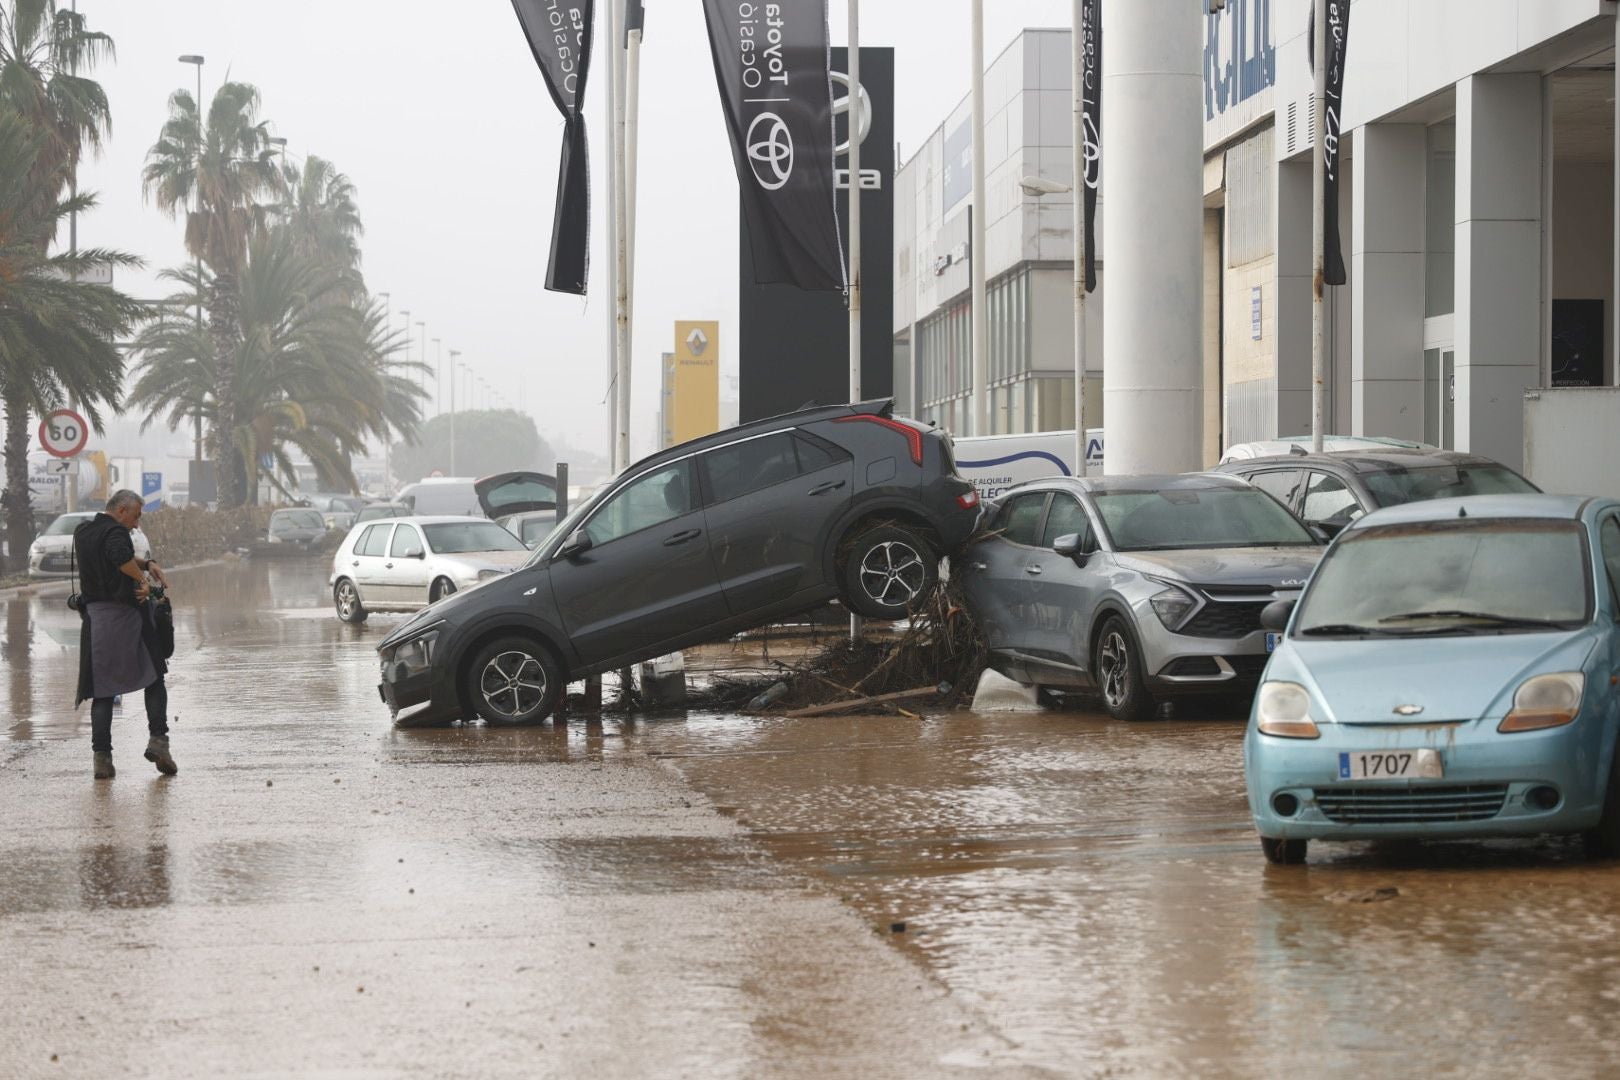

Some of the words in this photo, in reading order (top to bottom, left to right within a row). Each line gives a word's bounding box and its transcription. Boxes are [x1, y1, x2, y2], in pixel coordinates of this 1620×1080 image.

[50, 426, 77, 441] 60
[979, 477, 1012, 485] ALQUILER
[1360, 753, 1411, 777] 1707
